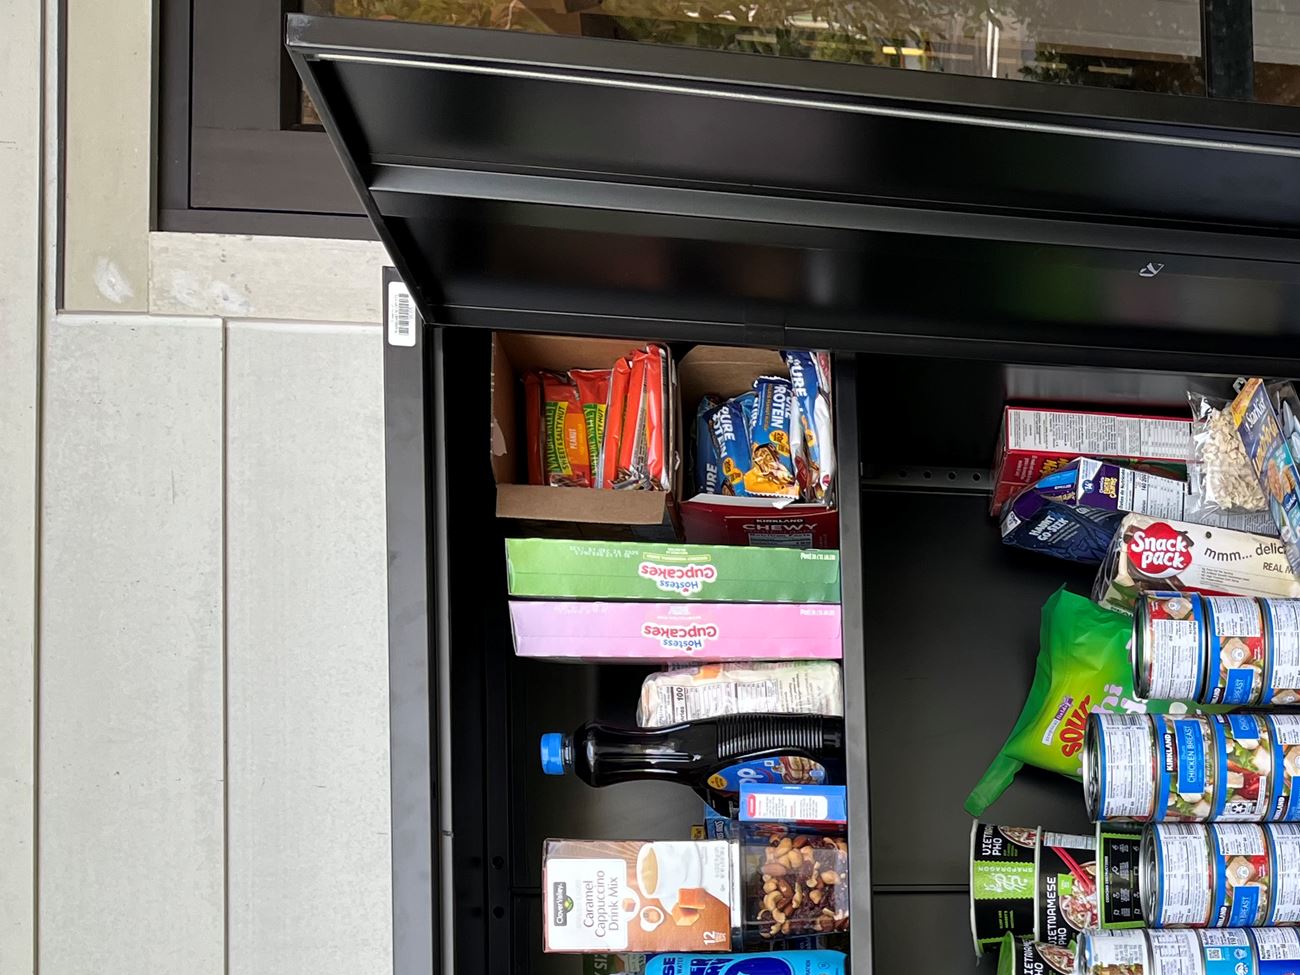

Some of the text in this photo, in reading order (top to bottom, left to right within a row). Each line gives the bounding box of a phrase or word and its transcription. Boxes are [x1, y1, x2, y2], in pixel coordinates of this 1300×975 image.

[555, 420, 567, 469] SWEET SALTY
[569, 428, 577, 449] PEANUT
[742, 523, 817, 531] CHEWY
[1130, 530, 1188, 552] Snack
[641, 565, 714, 579] Cupcakes
[1262, 562, 1282, 571] REAL
[659, 580, 698, 589] Hostess
[644, 625, 717, 638] Cupcakes
[662, 639, 702, 648] Hostess
[676, 687, 684, 701] 100
[1164, 733, 1173, 771] KIRKLAND
[1183, 726, 1196, 783] CHICKEN BREAST
[991, 838, 1002, 856] PHO
[584, 880, 594, 928] Caramel
[595, 870, 608, 937] Cappuccino
[608, 877, 619, 930] Drink Mix
[704, 931, 715, 945] 12
[1057, 928, 1067, 945] PHO
